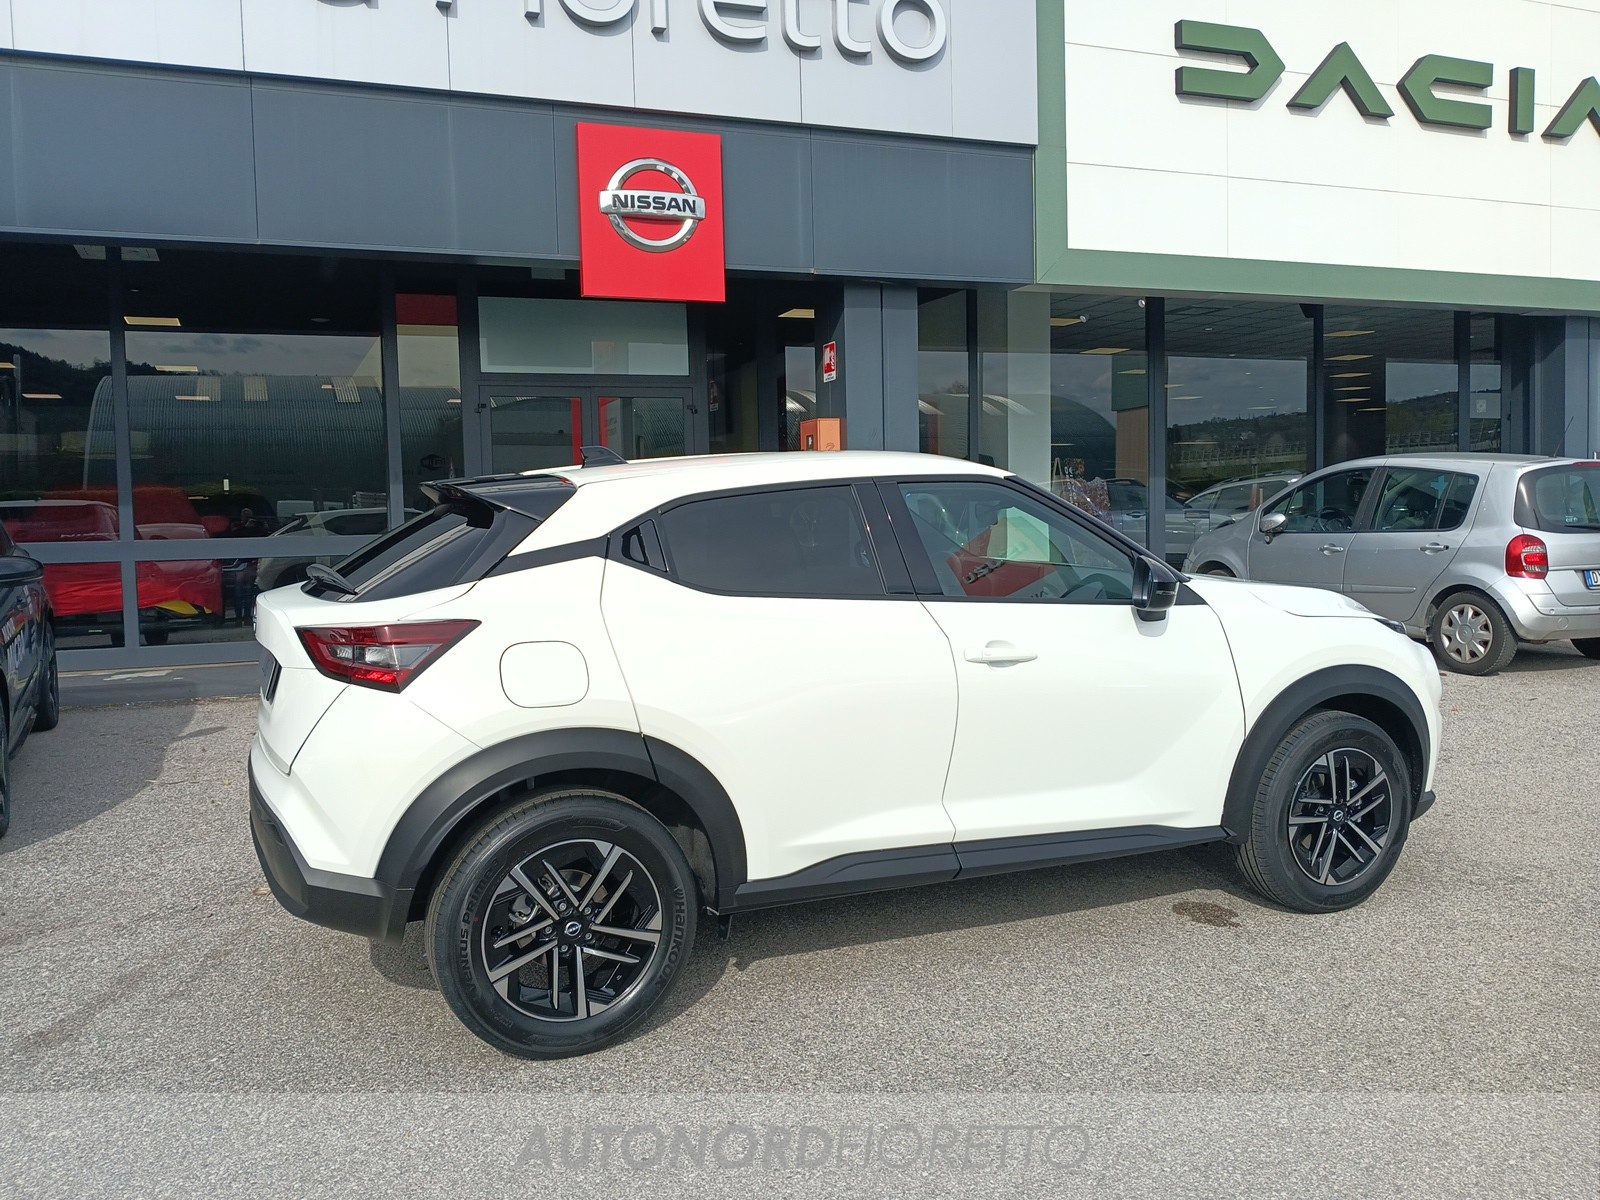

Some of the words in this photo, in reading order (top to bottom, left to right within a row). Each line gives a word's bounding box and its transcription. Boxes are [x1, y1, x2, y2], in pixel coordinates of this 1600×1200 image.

[436, 0, 947, 62] etto
[1174, 19, 1600, 138] DACIA
[611, 193, 697, 214] NISSAN
